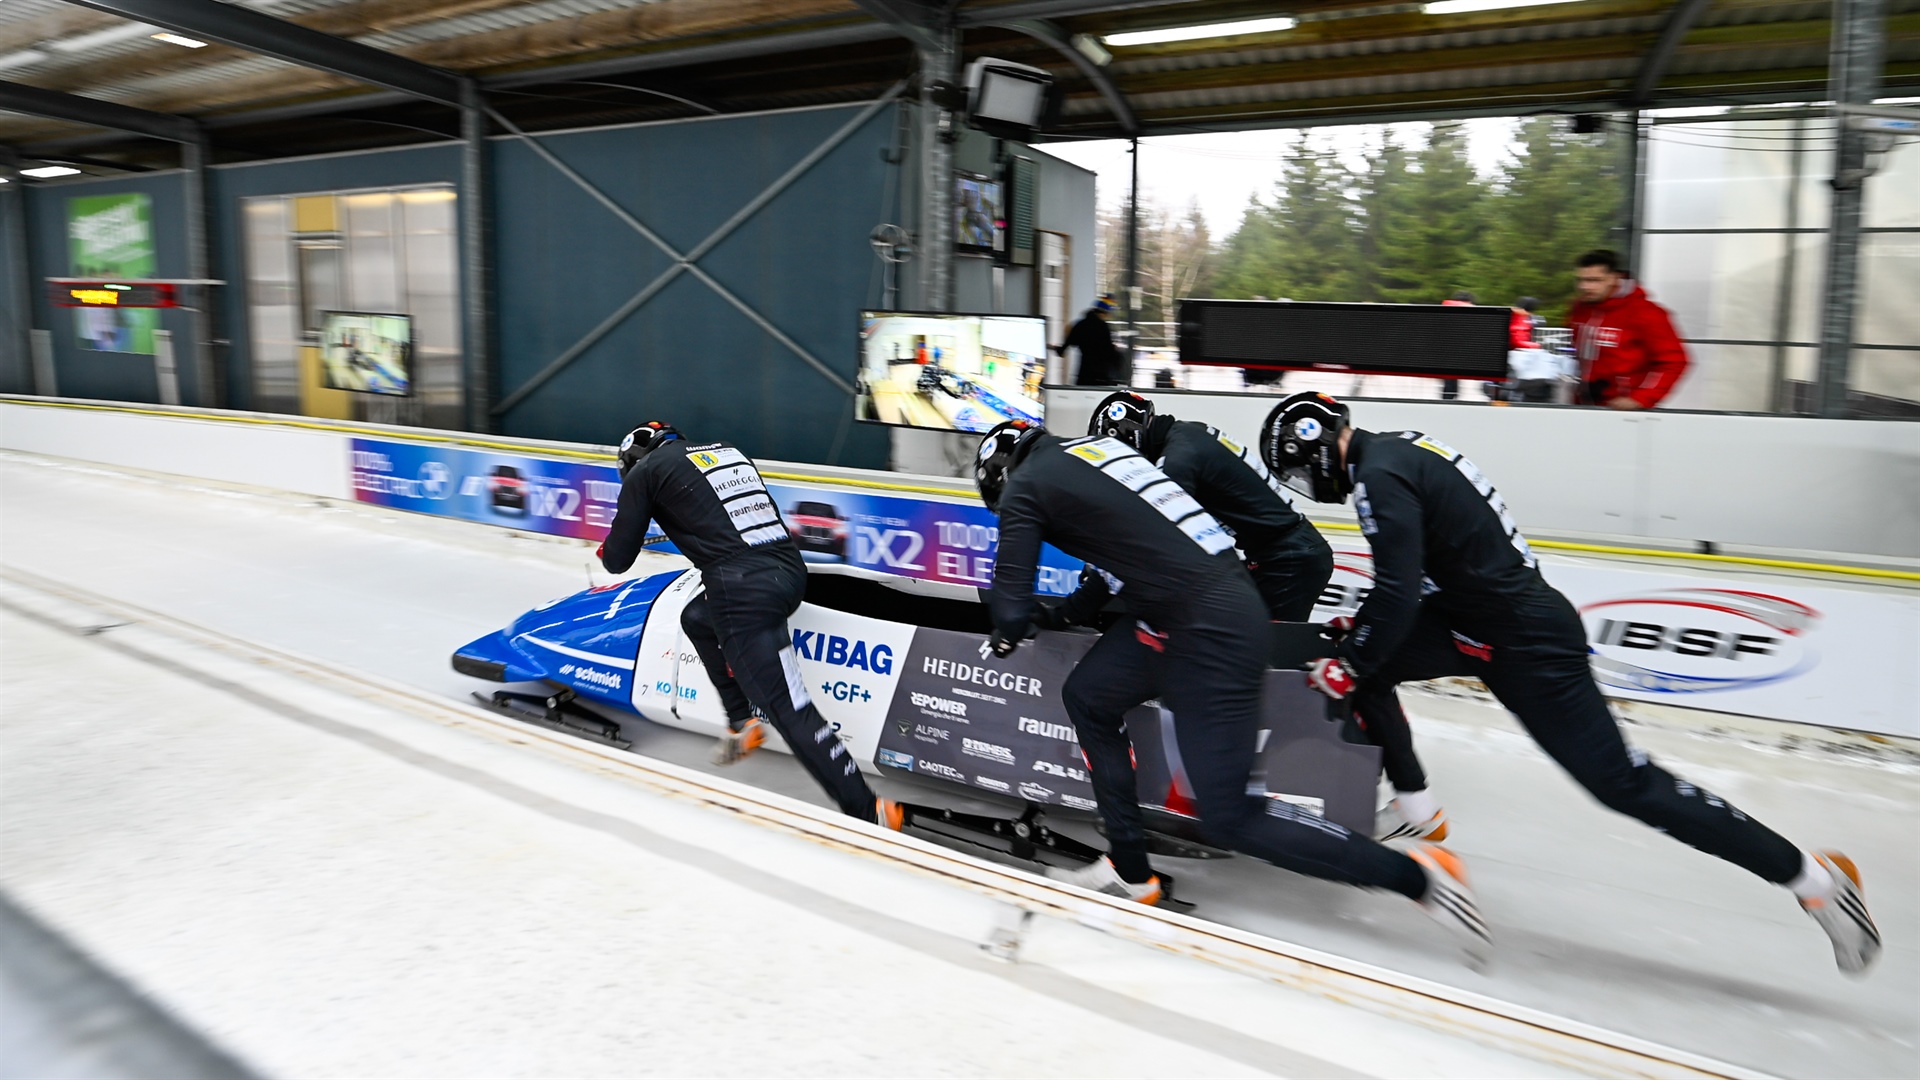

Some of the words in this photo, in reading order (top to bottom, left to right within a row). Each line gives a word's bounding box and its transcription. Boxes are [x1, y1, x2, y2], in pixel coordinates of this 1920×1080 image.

[855, 525, 927, 571] iX2
[792, 628, 893, 675] KIBAG
[1597, 618, 1784, 662] IBSF
[574, 666, 622, 689] schmidt
[922, 656, 1043, 698] HEIDEGGER
[910, 691, 968, 717] REPOWER
[915, 723, 950, 740] ALPINE
